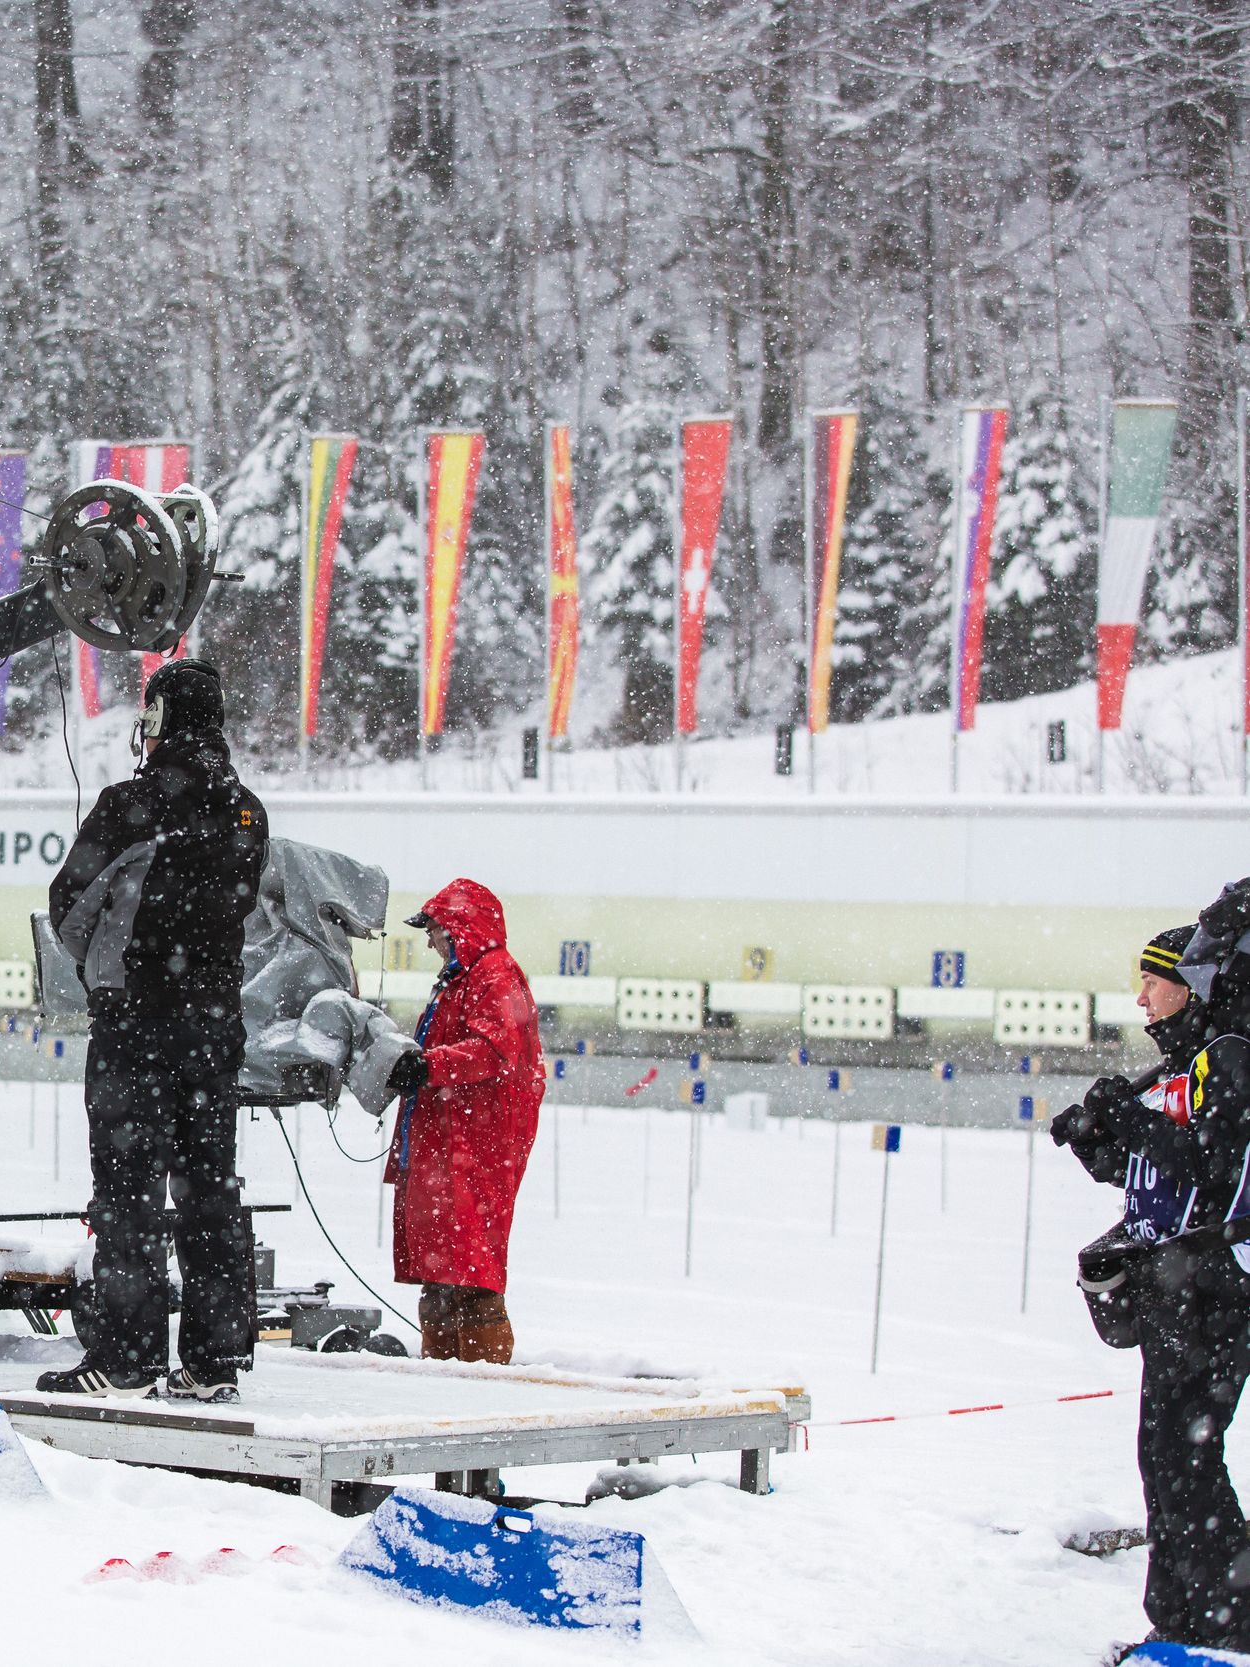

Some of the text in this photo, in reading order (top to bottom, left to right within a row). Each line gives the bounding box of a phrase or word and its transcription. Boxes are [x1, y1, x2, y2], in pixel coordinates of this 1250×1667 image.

[565, 942, 588, 976] 10
[749, 947, 766, 980] 9
[939, 950, 957, 988] 8
